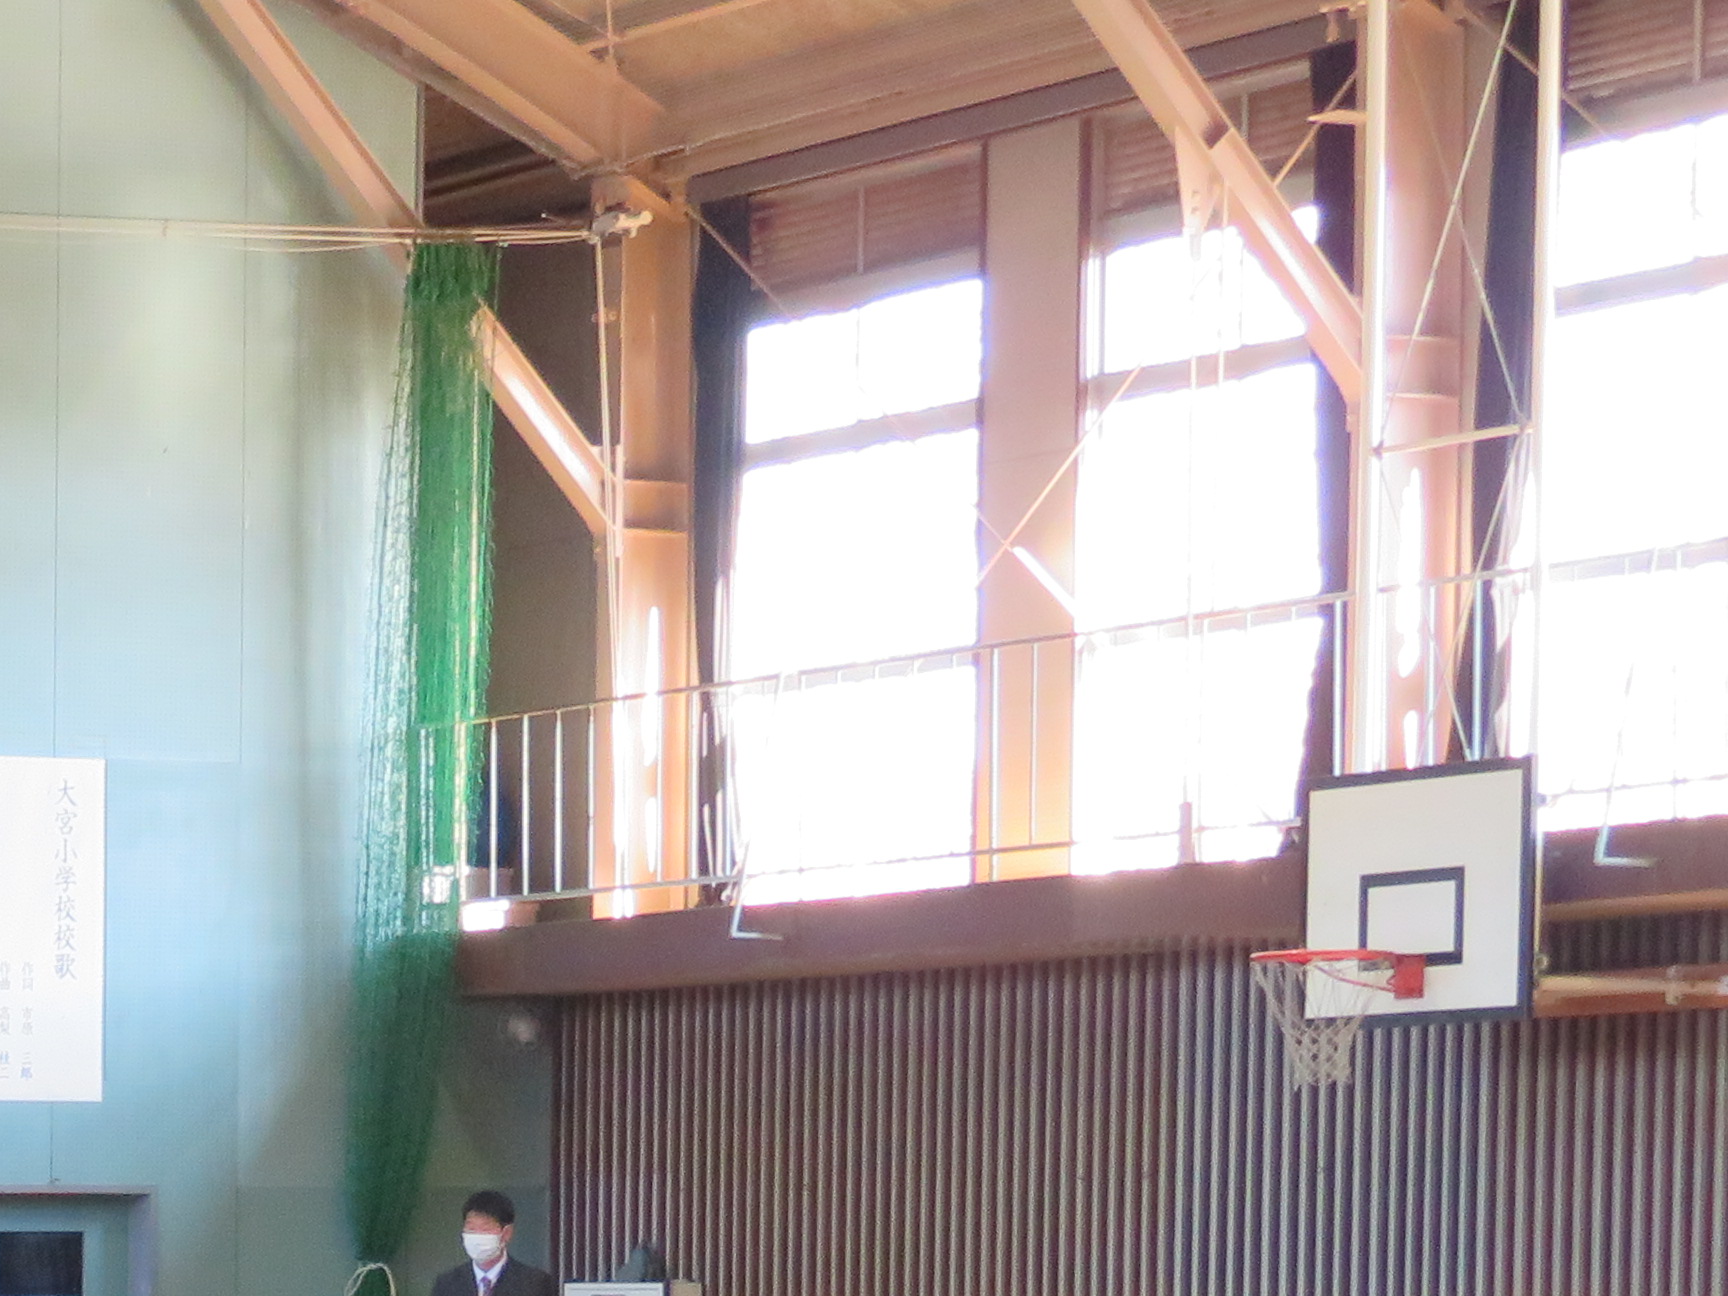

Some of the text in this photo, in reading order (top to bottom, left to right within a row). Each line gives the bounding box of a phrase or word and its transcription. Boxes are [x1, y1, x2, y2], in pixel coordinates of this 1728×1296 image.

[53, 778, 78, 981] 大宮小学校校歌
